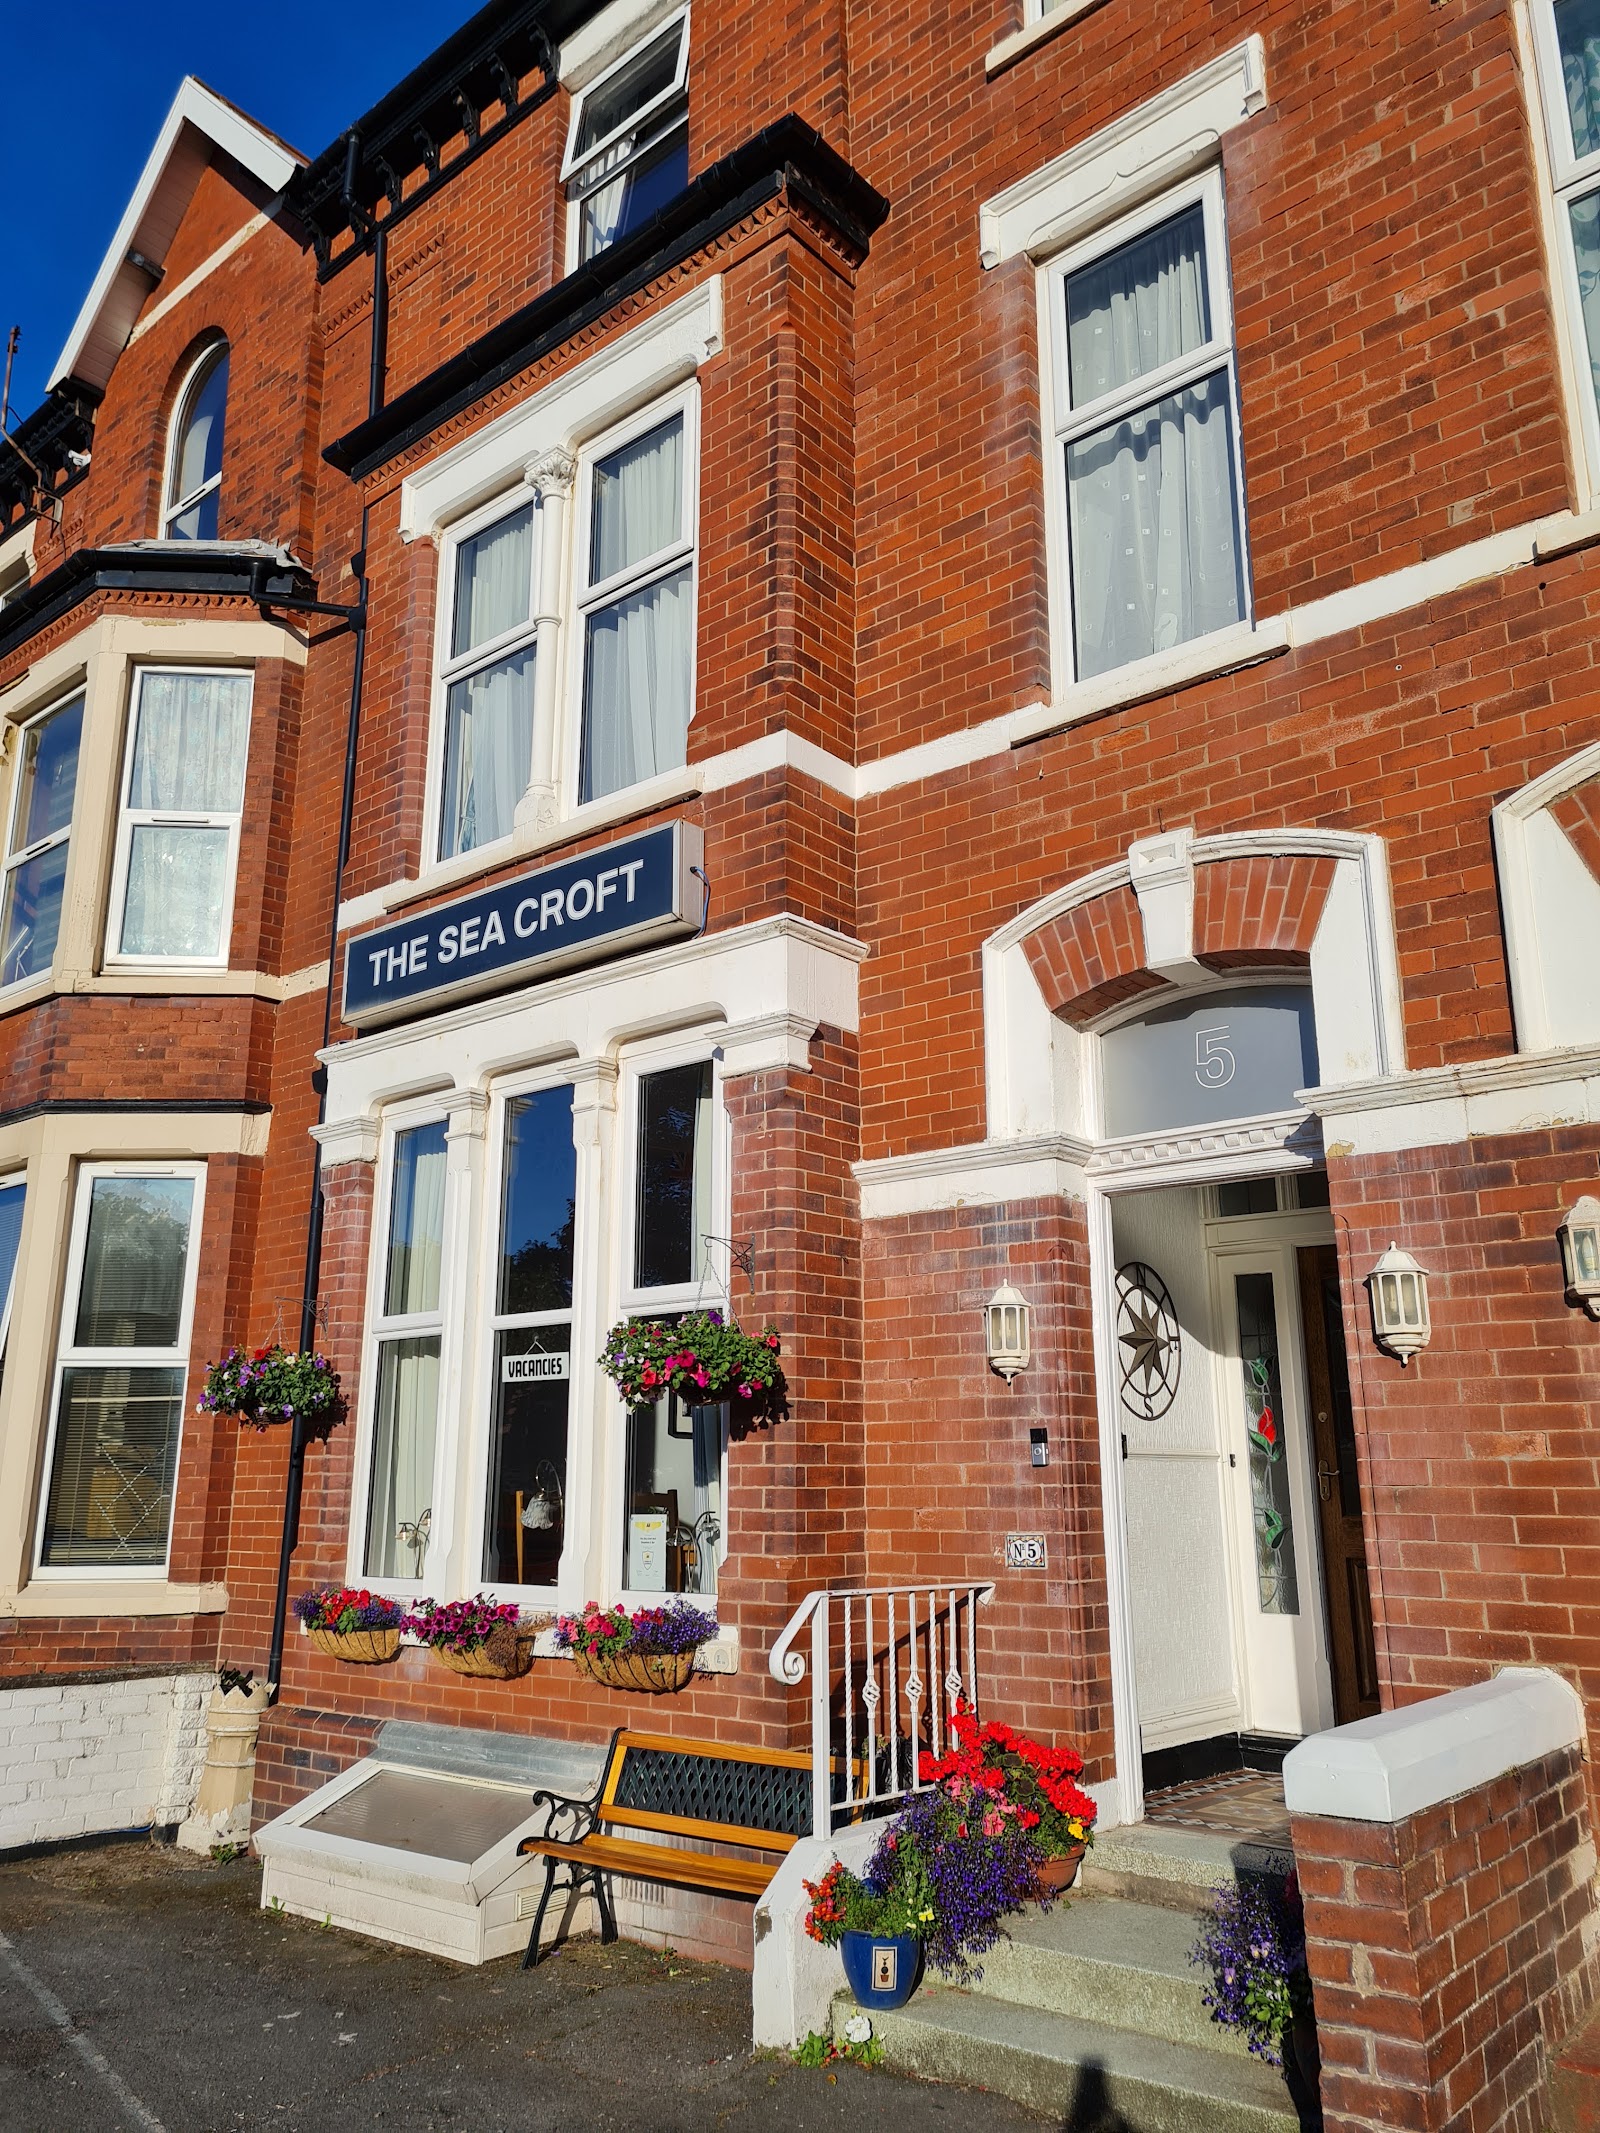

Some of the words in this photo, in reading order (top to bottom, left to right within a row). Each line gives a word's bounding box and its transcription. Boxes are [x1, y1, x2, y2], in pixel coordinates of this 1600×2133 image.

[368, 934, 429, 987] THE
[437, 909, 506, 964] SEA
[513, 858, 644, 938] CROFT
[1195, 1025, 1236, 1089] 5
[508, 1357, 562, 1378] VACANCIES
[1027, 1543, 1037, 1559] 5
